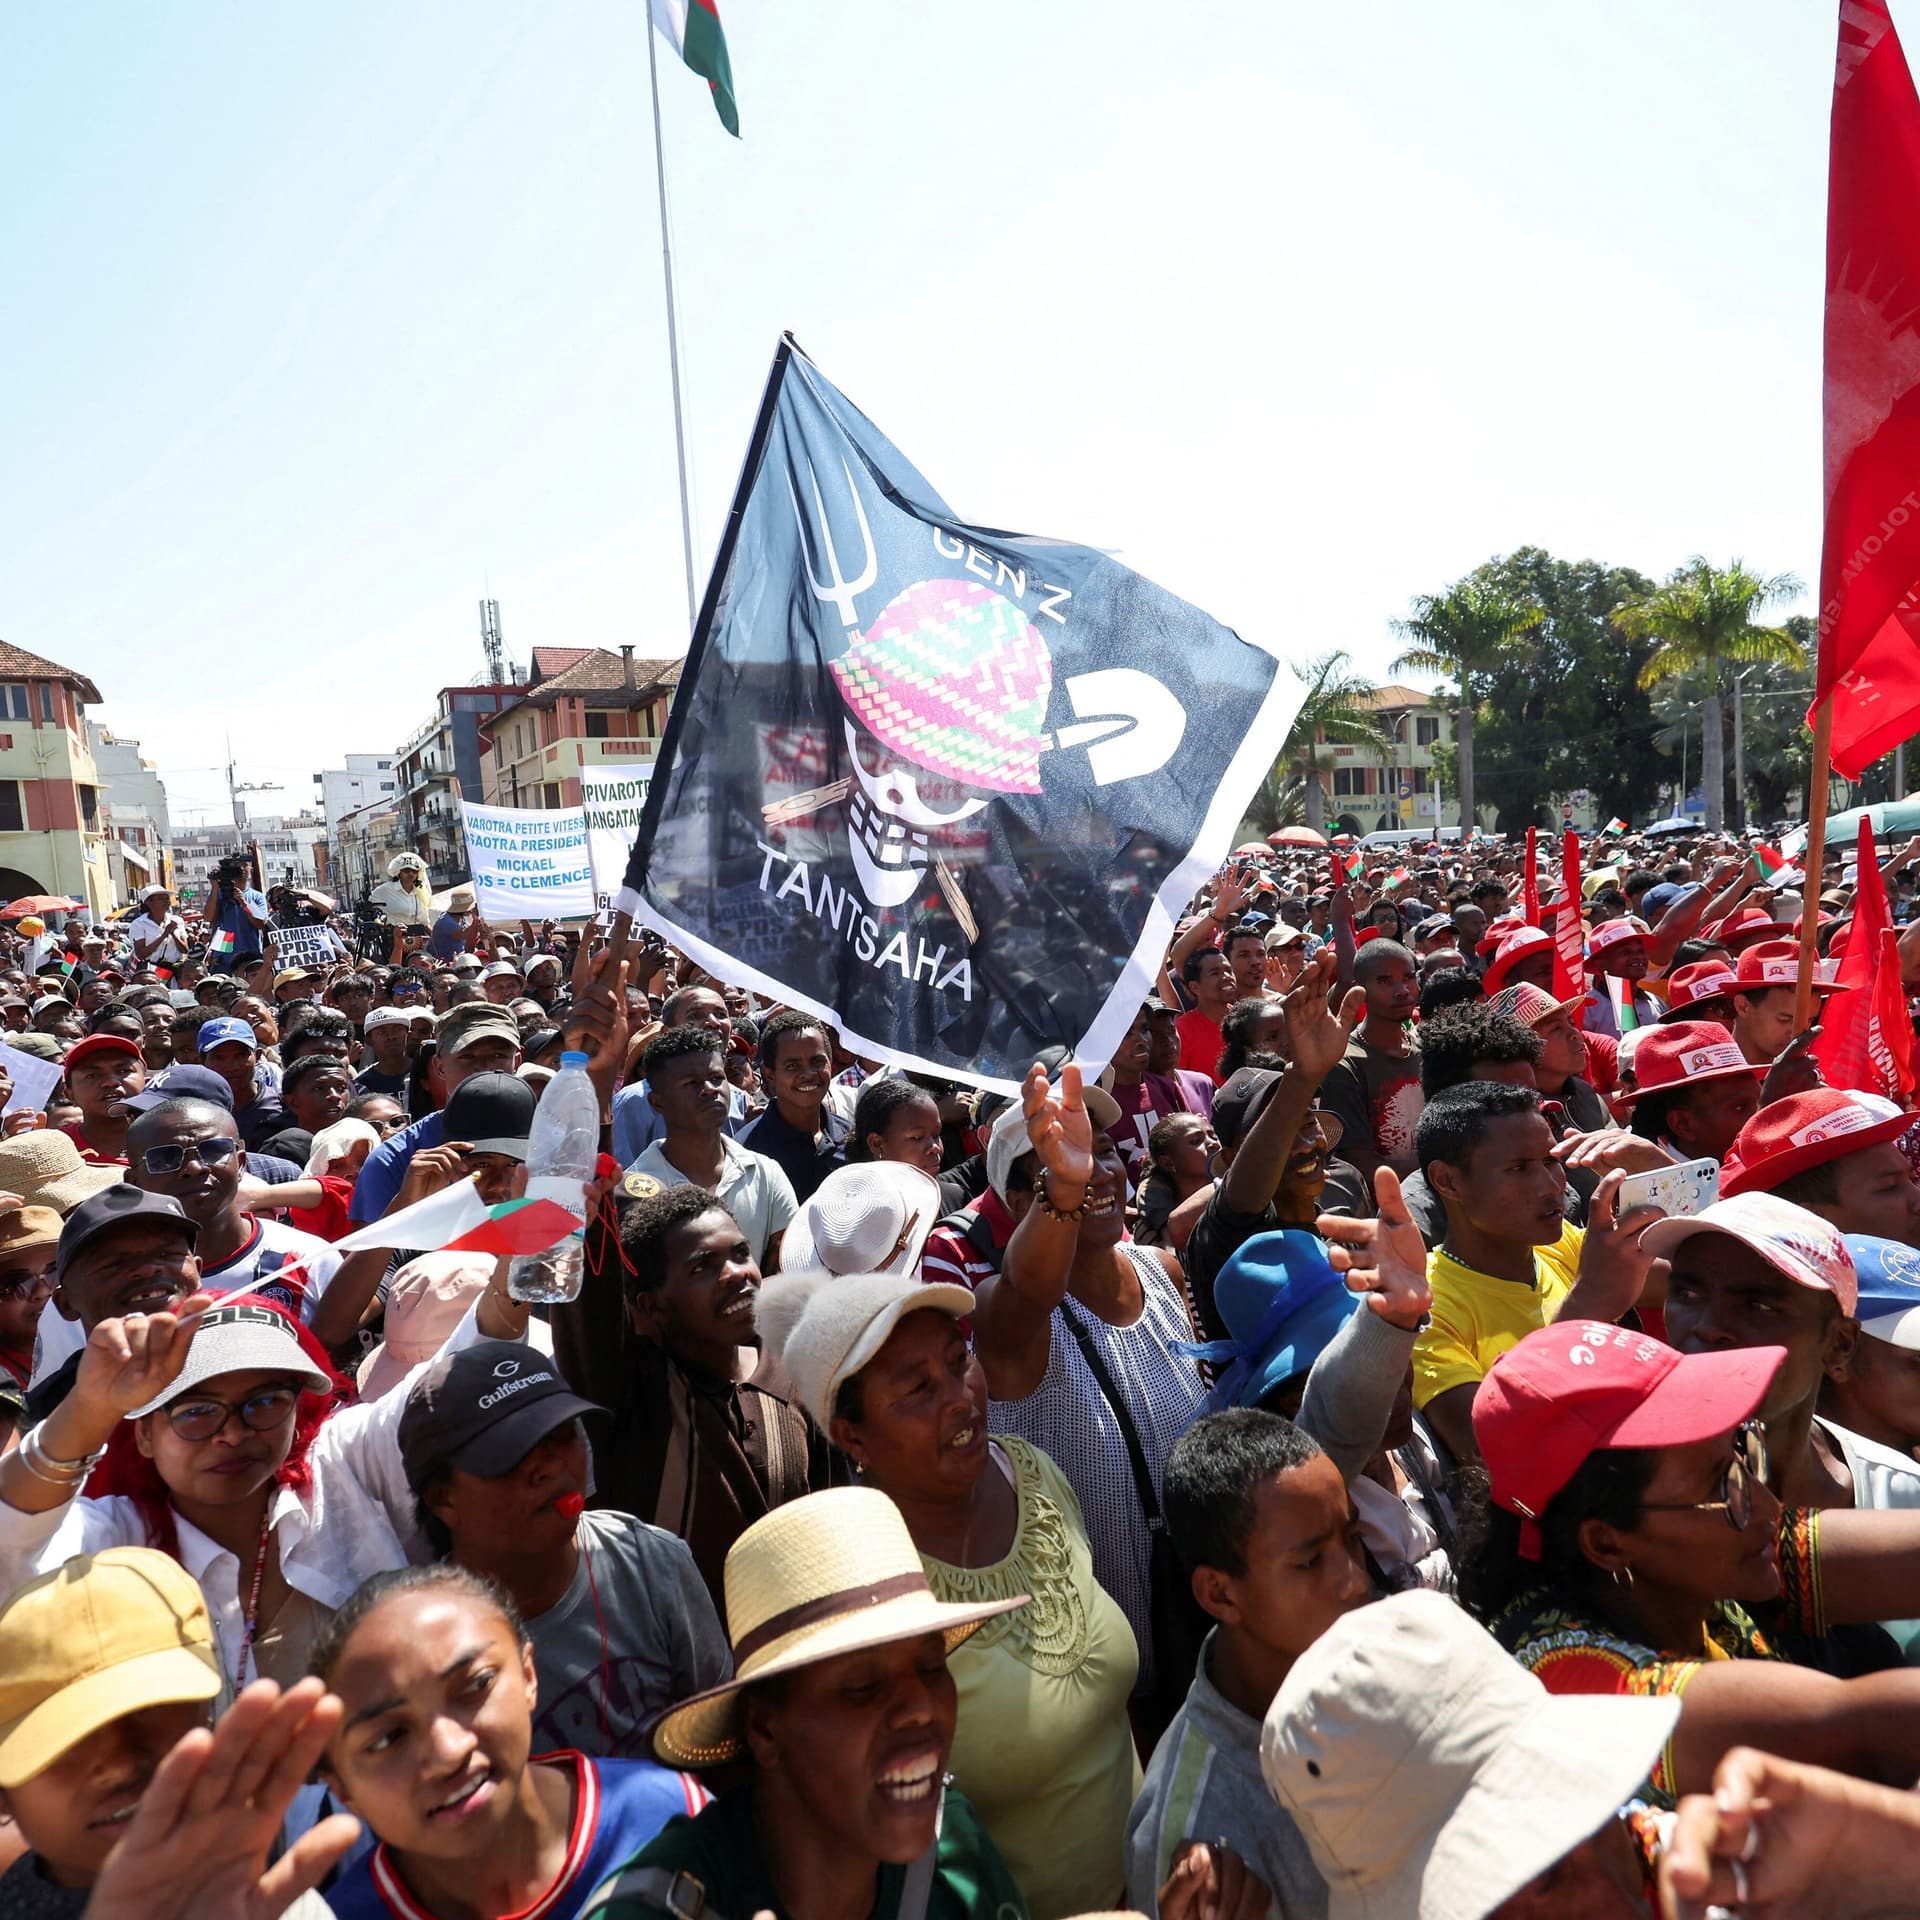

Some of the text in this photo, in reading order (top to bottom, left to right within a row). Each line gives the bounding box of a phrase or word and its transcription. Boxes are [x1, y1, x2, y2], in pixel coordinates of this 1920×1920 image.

[933, 526, 1073, 624] GEN Z
[515, 822, 550, 835] PETITE
[521, 832, 588, 851] PRESIDENT
[497, 857, 557, 872] MICKAEL
[511, 866, 592, 889] CLEMENCE
[757, 840, 972, 1001] TANTSAHA
[270, 926, 327, 945] CLEMENCE
[281, 938, 322, 956] PDS
[276, 950, 333, 968] TANA
[478, 1371, 553, 1409] Gulfstream
